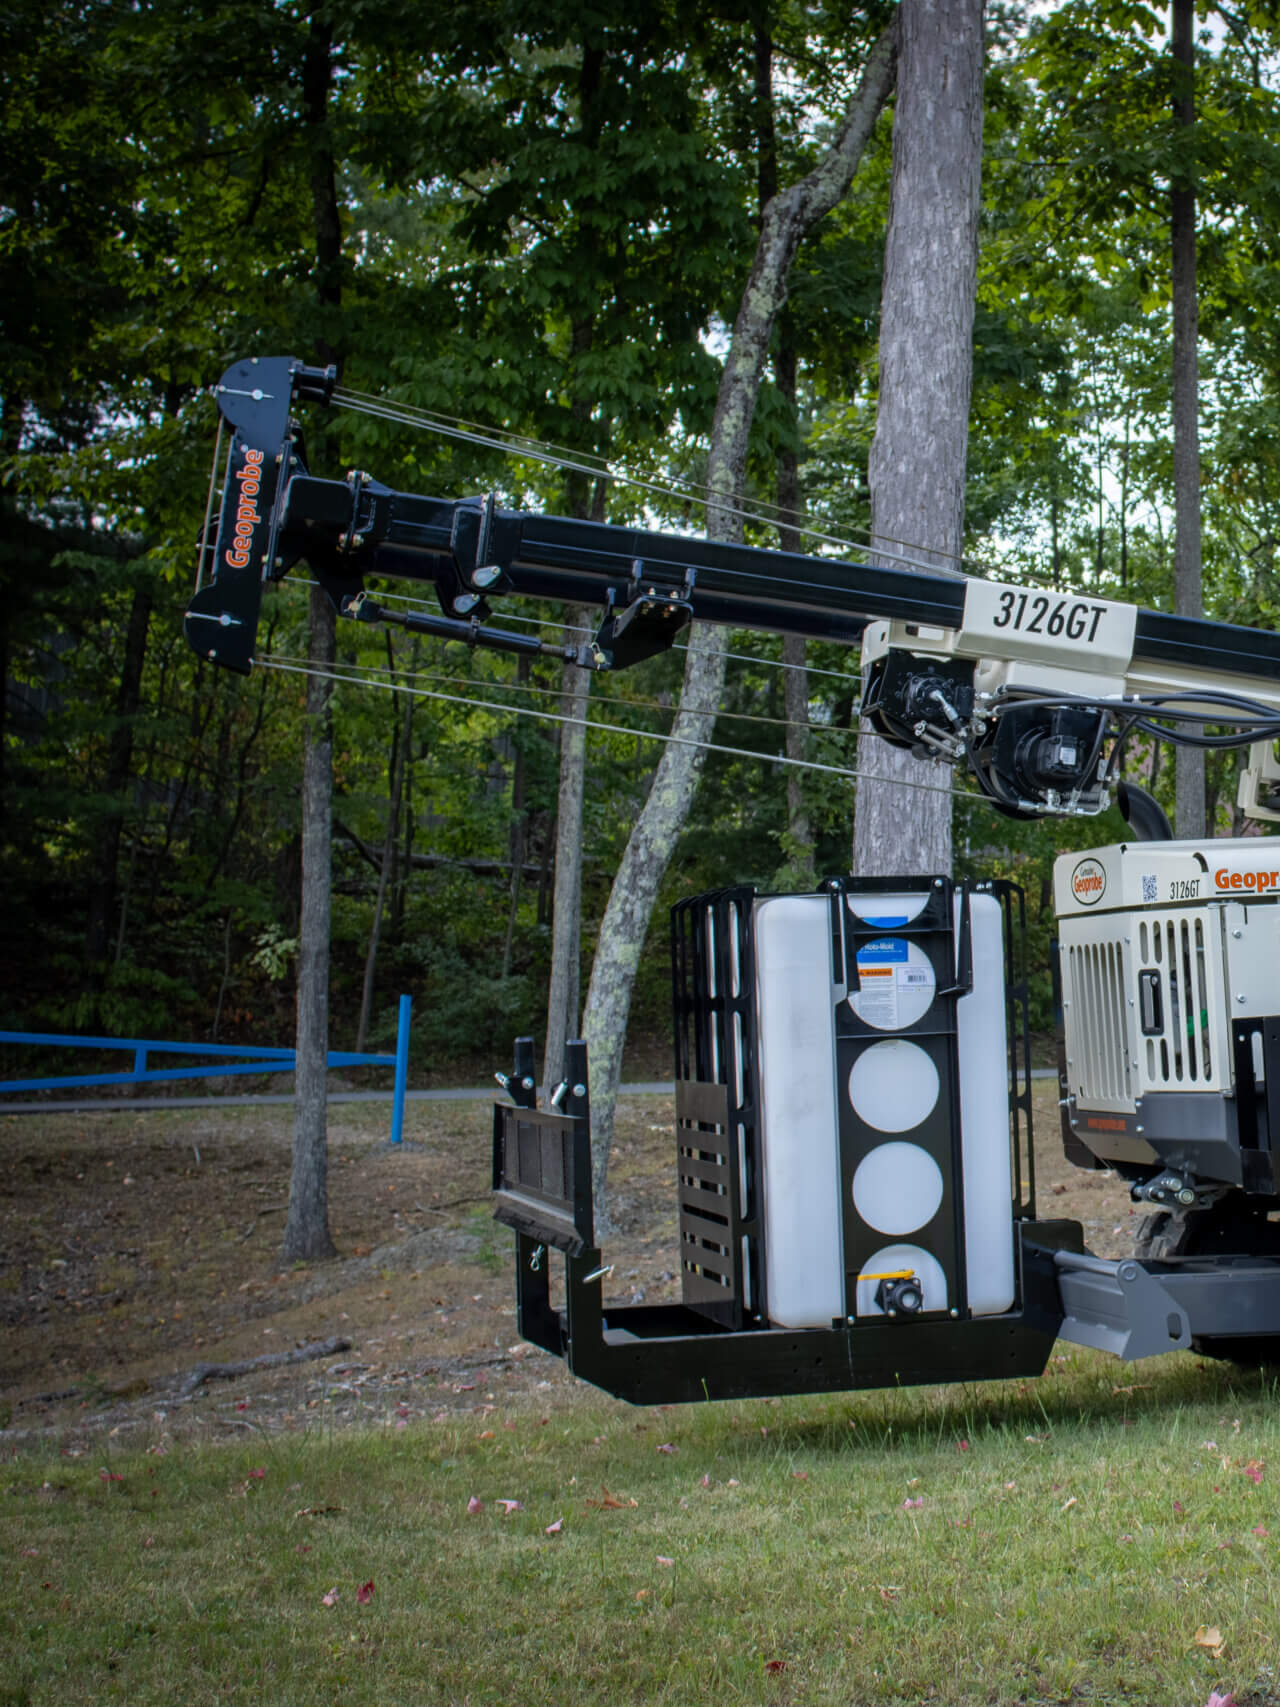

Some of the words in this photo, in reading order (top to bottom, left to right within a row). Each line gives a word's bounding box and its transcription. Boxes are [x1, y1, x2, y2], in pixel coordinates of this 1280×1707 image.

[225, 449, 264, 568] Geoprobe
[993, 591, 1107, 643] 3126GT
[1074, 871, 1103, 896] Geoprobe
[1170, 879, 1201, 900] 3126GT
